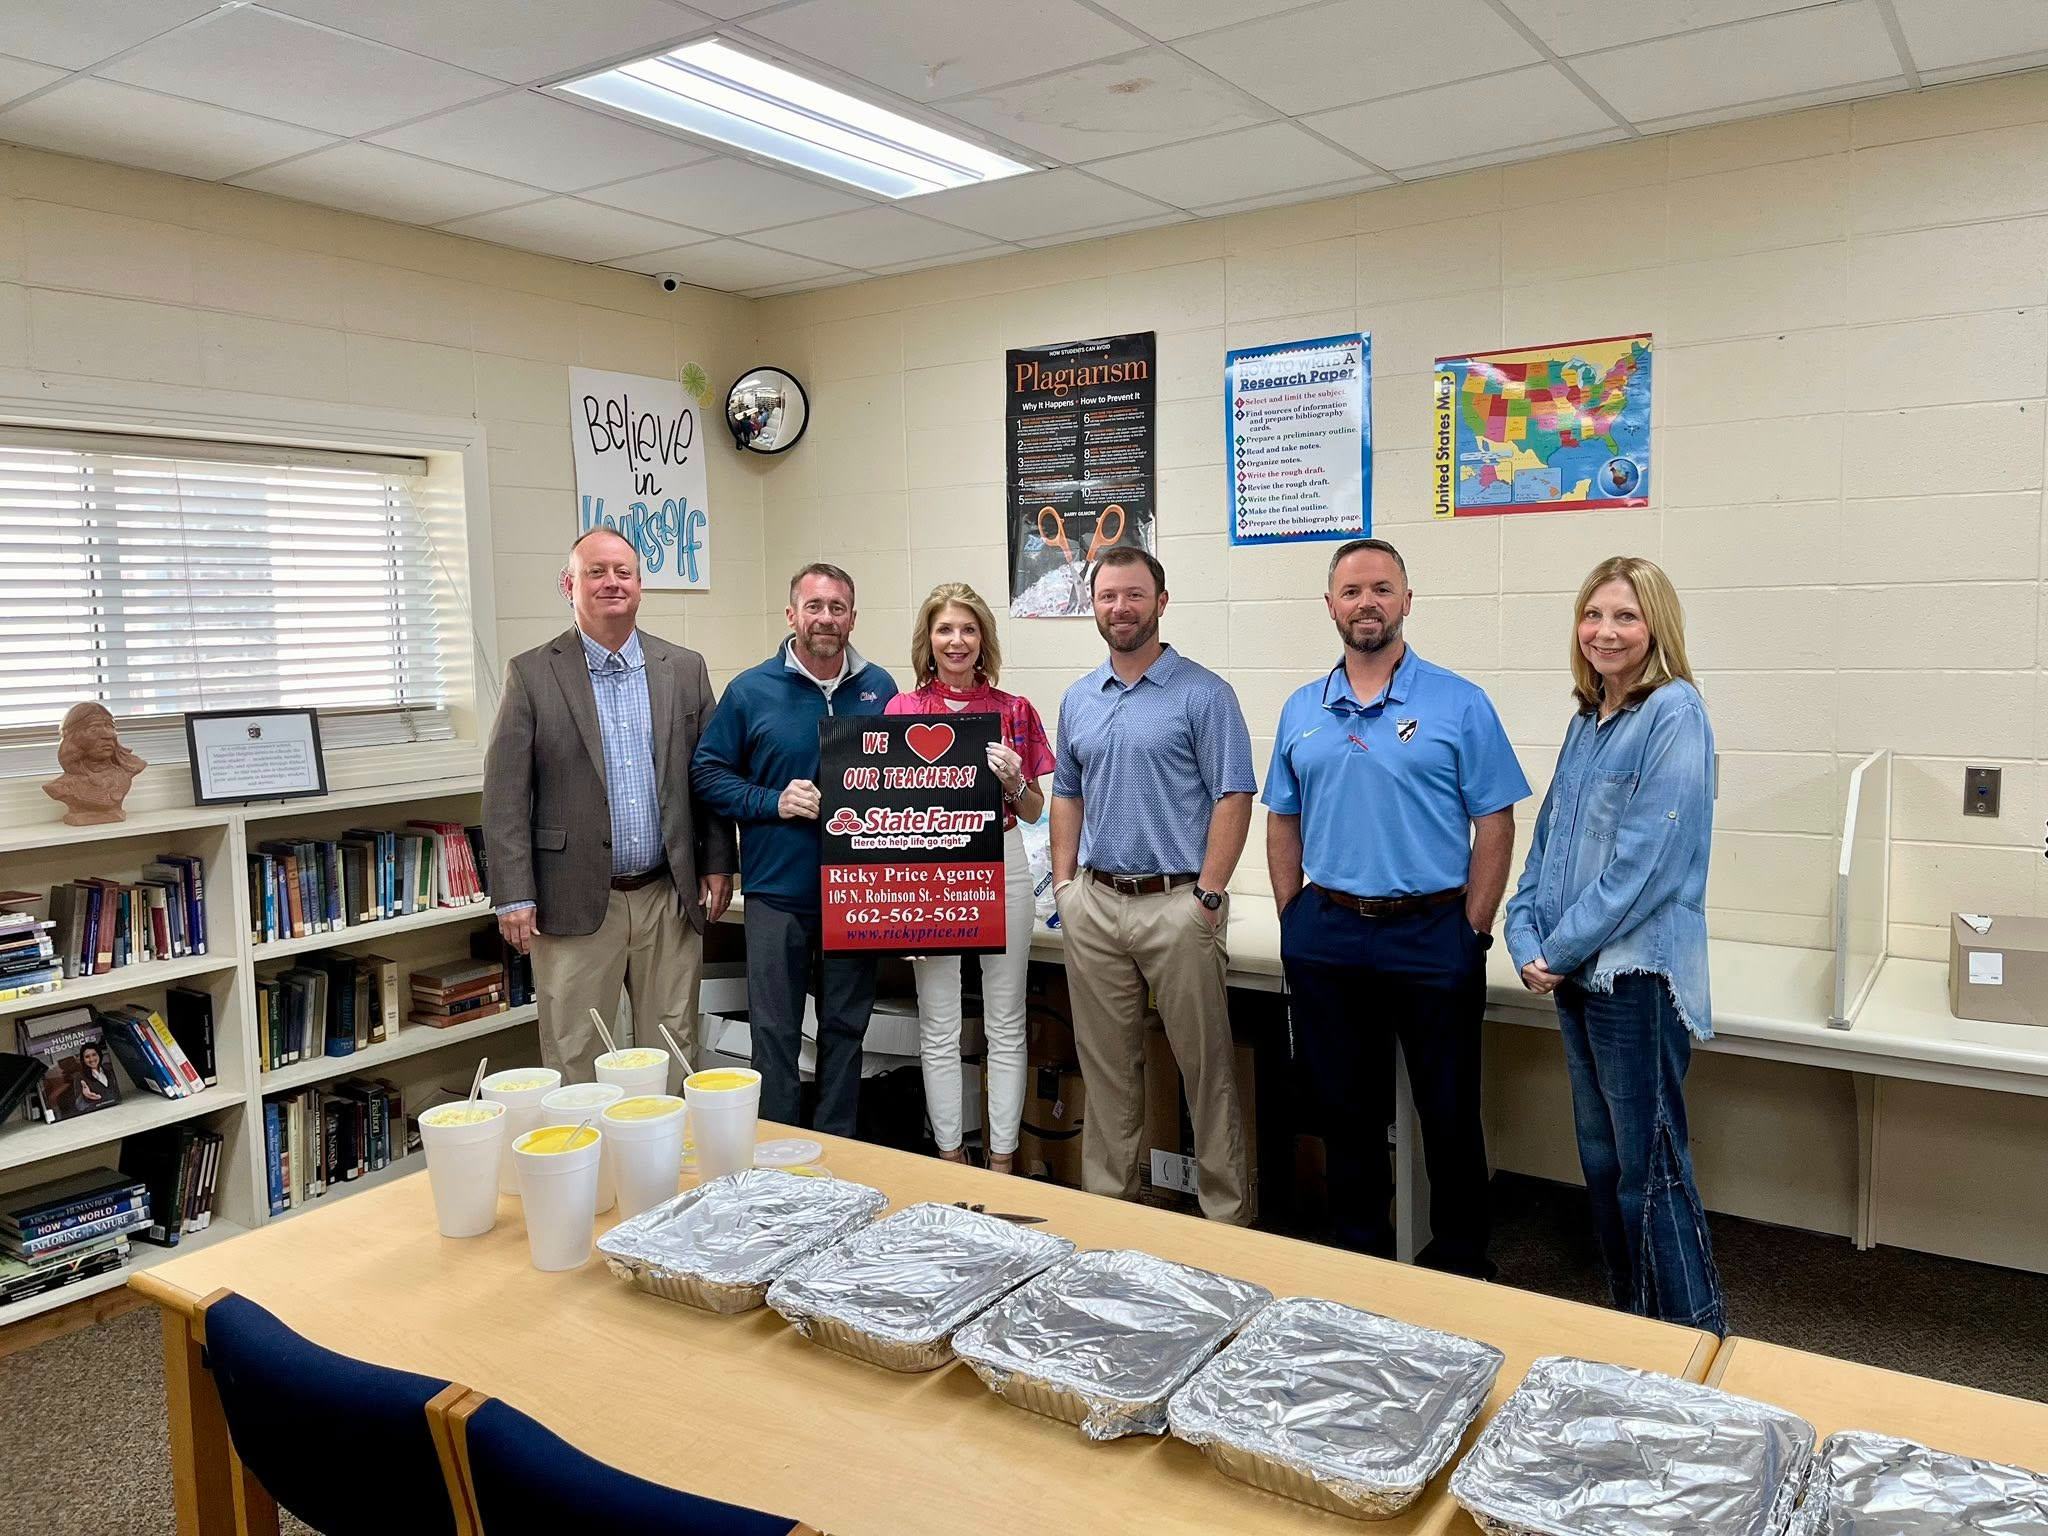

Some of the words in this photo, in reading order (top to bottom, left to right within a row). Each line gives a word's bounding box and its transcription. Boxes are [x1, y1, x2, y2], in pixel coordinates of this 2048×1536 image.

[1061, 346, 1085, 355] STUDENTS
[1096, 343, 1111, 351] AVOID
[1343, 352, 1356, 365] A
[1015, 354, 1149, 398] Plagiarism
[1240, 371, 1306, 391] Research
[1246, 397, 1267, 405] Select
[1269, 395, 1283, 403] and
[1284, 391, 1302, 401] limit
[1304, 391, 1317, 399] the
[1436, 376, 1455, 411] Map
[1022, 402, 1038, 412] Why
[1044, 399, 1075, 410] Happens
[1080, 397, 1098, 406] How
[1098, 395, 1106, 403] to
[1107, 392, 1134, 404] Prevent
[1134, 391, 1141, 400] It
[1246, 410, 1263, 418] Find
[1264, 407, 1292, 416] sources
[1293, 404, 1301, 412] of
[1302, 401, 1348, 411] information
[1249, 417, 1264, 425] and
[1265, 413, 1294, 426] prepare
[1295, 408, 1344, 420] bibliography
[1016, 419, 1022, 430] 1
[1083, 413, 1091, 424] 6
[583, 394, 694, 473] Believe
[1246, 433, 1275, 444] Prepare
[1283, 429, 1327, 441] preliminary
[1328, 426, 1358, 436] outline.
[1249, 424, 1272, 432] cards.
[1084, 431, 1091, 441] 7
[1436, 413, 1451, 461] States
[1017, 441, 1024, 451] 2
[1083, 448, 1091, 459] 8
[1246, 447, 1265, 455] Read
[1266, 445, 1280, 453] and
[1281, 443, 1298, 451] take
[1299, 442, 1322, 450] notes.
[1017, 457, 1025, 468] 3
[1246, 458, 1279, 468] Organize
[1280, 457, 1303, 465] notes.
[1083, 469, 1091, 480] 9
[1247, 471, 1267, 479] Write
[1268, 469, 1280, 477] the
[1281, 468, 1303, 478] rough
[1304, 465, 1326, 474] draft.
[635, 466, 663, 496] in
[1018, 477, 1025, 489] 4
[1247, 483, 1271, 492] Revise
[1272, 482, 1284, 490] the
[1285, 480, 1308, 490] rough
[1309, 478, 1330, 487] draft.
[1081, 487, 1091, 499] 10
[1247, 495, 1267, 504] Write
[1268, 493, 1280, 502] the
[1281, 492, 1299, 501] final
[1300, 490, 1321, 499] draft.
[1436, 463, 1450, 516] United
[1018, 494, 1025, 505] 5
[1248, 506, 1267, 515] Make
[1268, 505, 1280, 514] the
[1281, 503, 1300, 513] final
[1300, 503, 1329, 512] outline.
[1248, 518, 1277, 528] Prepare
[1278, 516, 1291, 525] the
[1291, 514, 1340, 526] bibliography
[1340, 513, 1362, 522] page.
[863, 732, 888, 754] WE
[844, 767, 879, 791] OUR
[883, 766, 977, 790] TEACHERS!
[854, 839, 875, 847] Here
[877, 838, 887, 847] to
[889, 837, 908, 849] help
[910, 837, 925, 846] life
[927, 838, 939, 847] go
[940, 836, 964, 847] right.
[828, 869, 879, 886] Ricky
[884, 867, 928, 882] Price
[933, 866, 995, 885] Agency
[828, 889, 847, 905] 105
[849, 889, 862, 904] N.
[865, 888, 916, 904] Robinson
[918, 887, 934, 903] St.
[943, 886, 996, 902] Senatobia
[845, 906, 980, 924] 662-562-5623
[847, 924, 979, 943] www.rickyprice.net
[44, 1035, 97, 1056] RESOURCES
[52, 1031, 85, 1046] HUMAN
[38, 1222, 61, 1235] HOW
[78, 1205, 118, 1223] WORLD?
[31, 1231, 81, 1252] EXPLORING
[94, 1214, 129, 1232] NATURE
